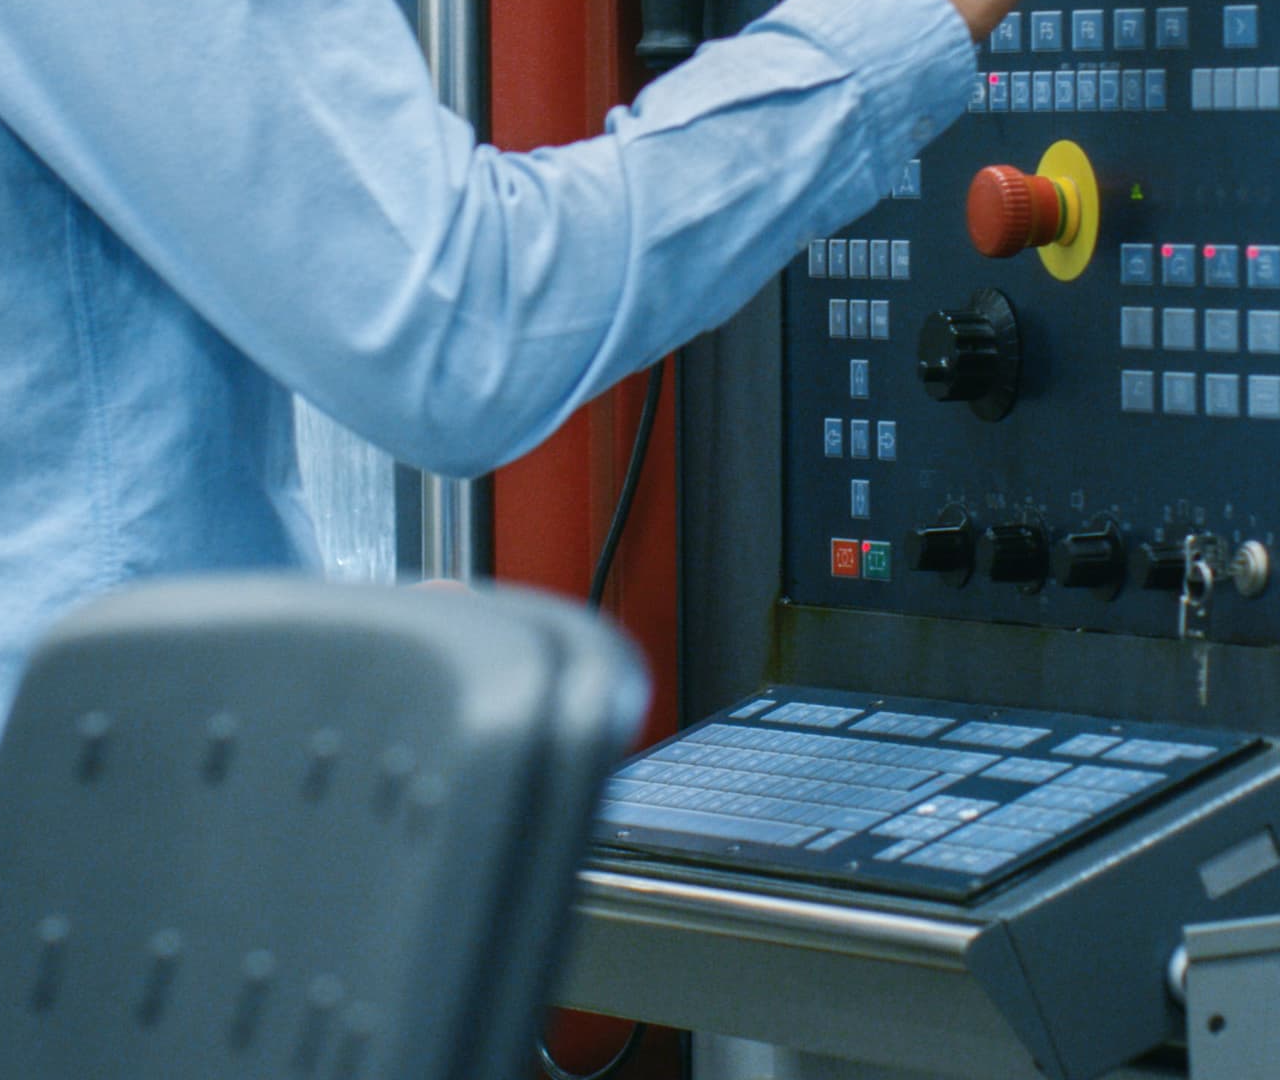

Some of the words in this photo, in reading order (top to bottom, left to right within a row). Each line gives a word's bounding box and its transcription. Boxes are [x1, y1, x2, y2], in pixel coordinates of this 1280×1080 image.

[999, 22, 1013, 41] F4
[1039, 21, 1055, 41] F5
[1080, 20, 1096, 40] F6
[1122, 19, 1137, 38] F7
